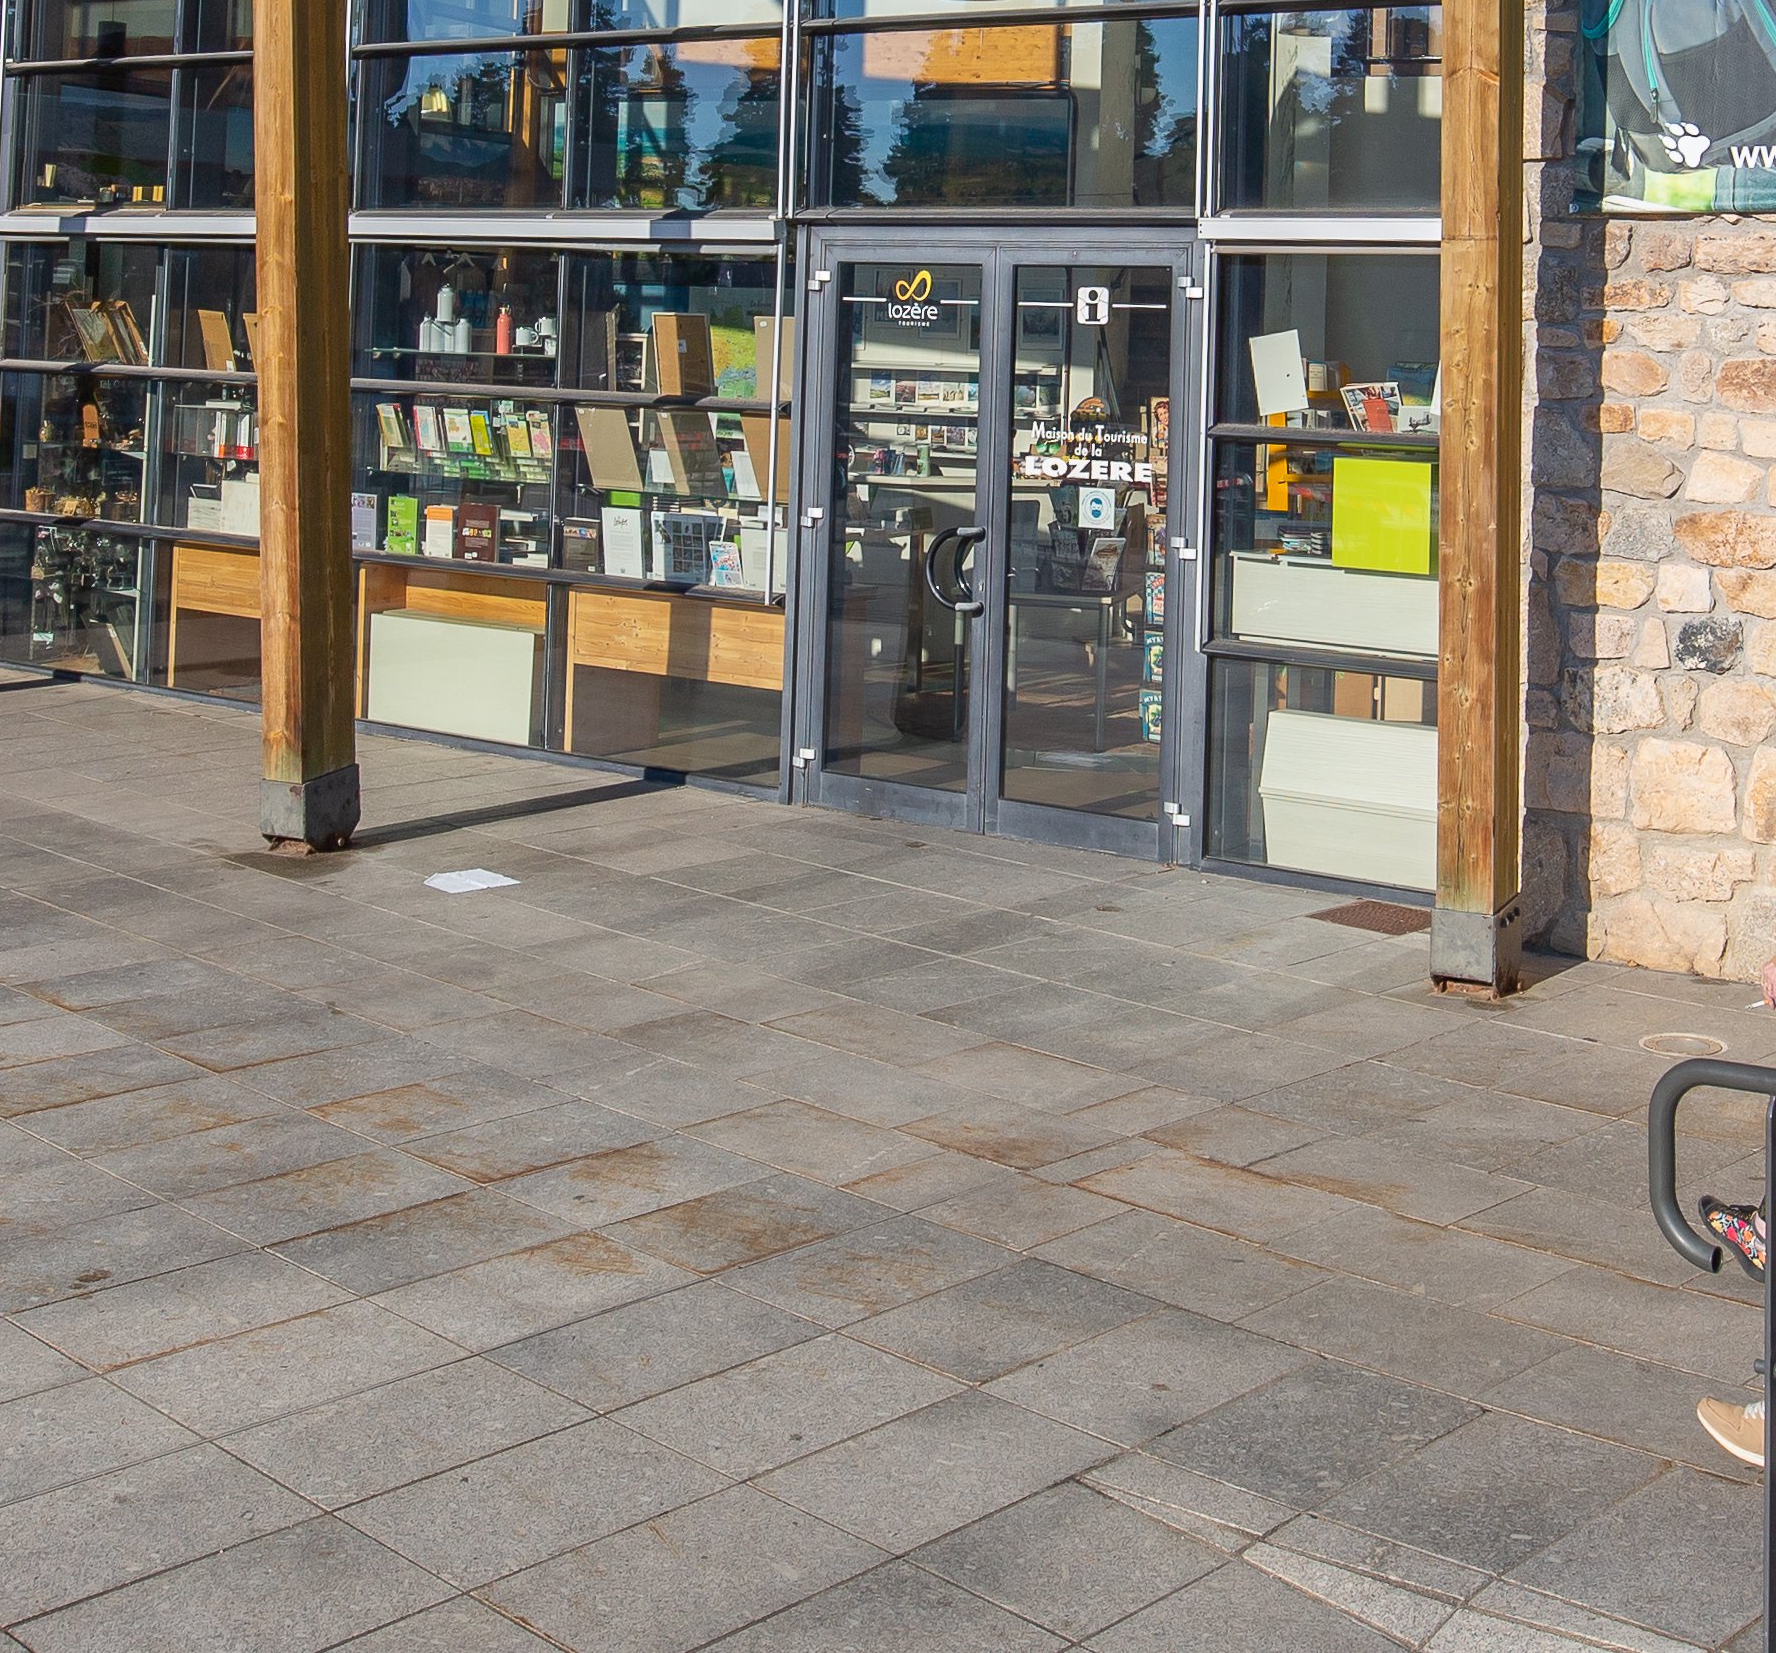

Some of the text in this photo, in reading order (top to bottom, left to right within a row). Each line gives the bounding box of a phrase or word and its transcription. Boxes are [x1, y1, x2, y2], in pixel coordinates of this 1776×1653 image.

[887, 302, 938, 320] lozère
[1031, 420, 1148, 445] Maison du Tourisme
[1074, 444, 1103, 457] de la
[1024, 455, 1153, 483] LOZERE
